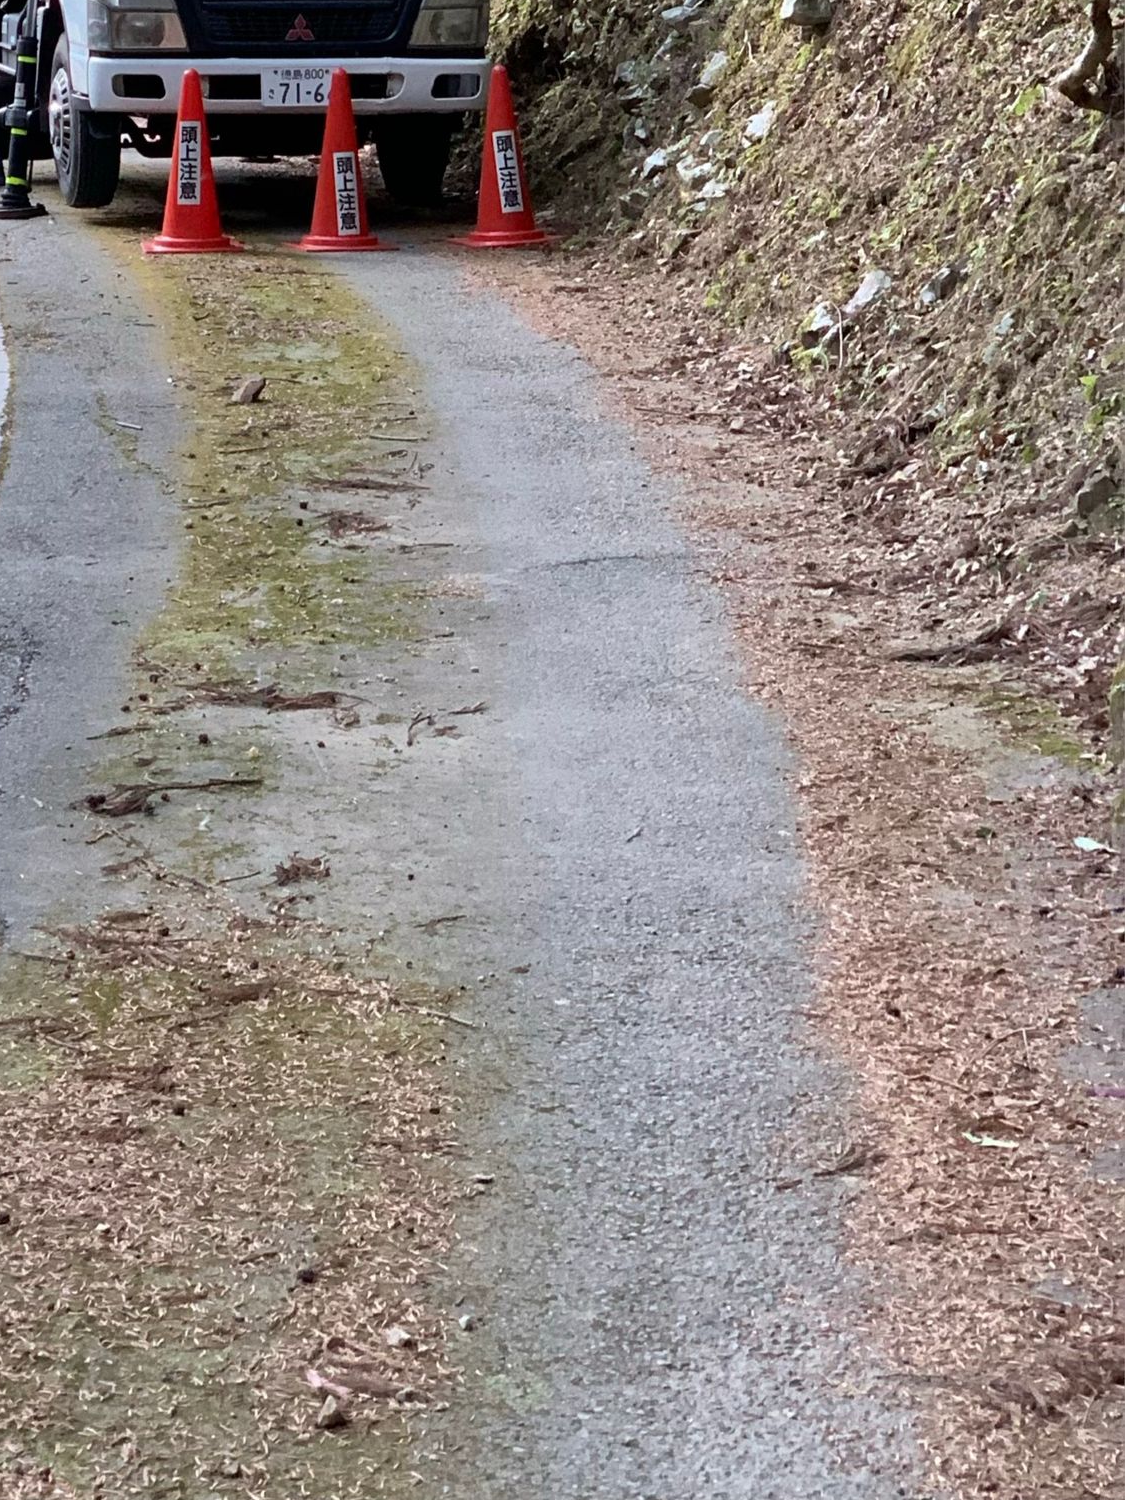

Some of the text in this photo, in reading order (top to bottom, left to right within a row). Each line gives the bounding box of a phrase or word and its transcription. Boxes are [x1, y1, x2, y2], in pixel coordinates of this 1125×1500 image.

[279, 82, 331, 104] 71-6
[179, 126, 198, 200] 頭上注意
[336, 156, 357, 230] 頭上注意
[496, 135, 521, 208] 頭上注意
